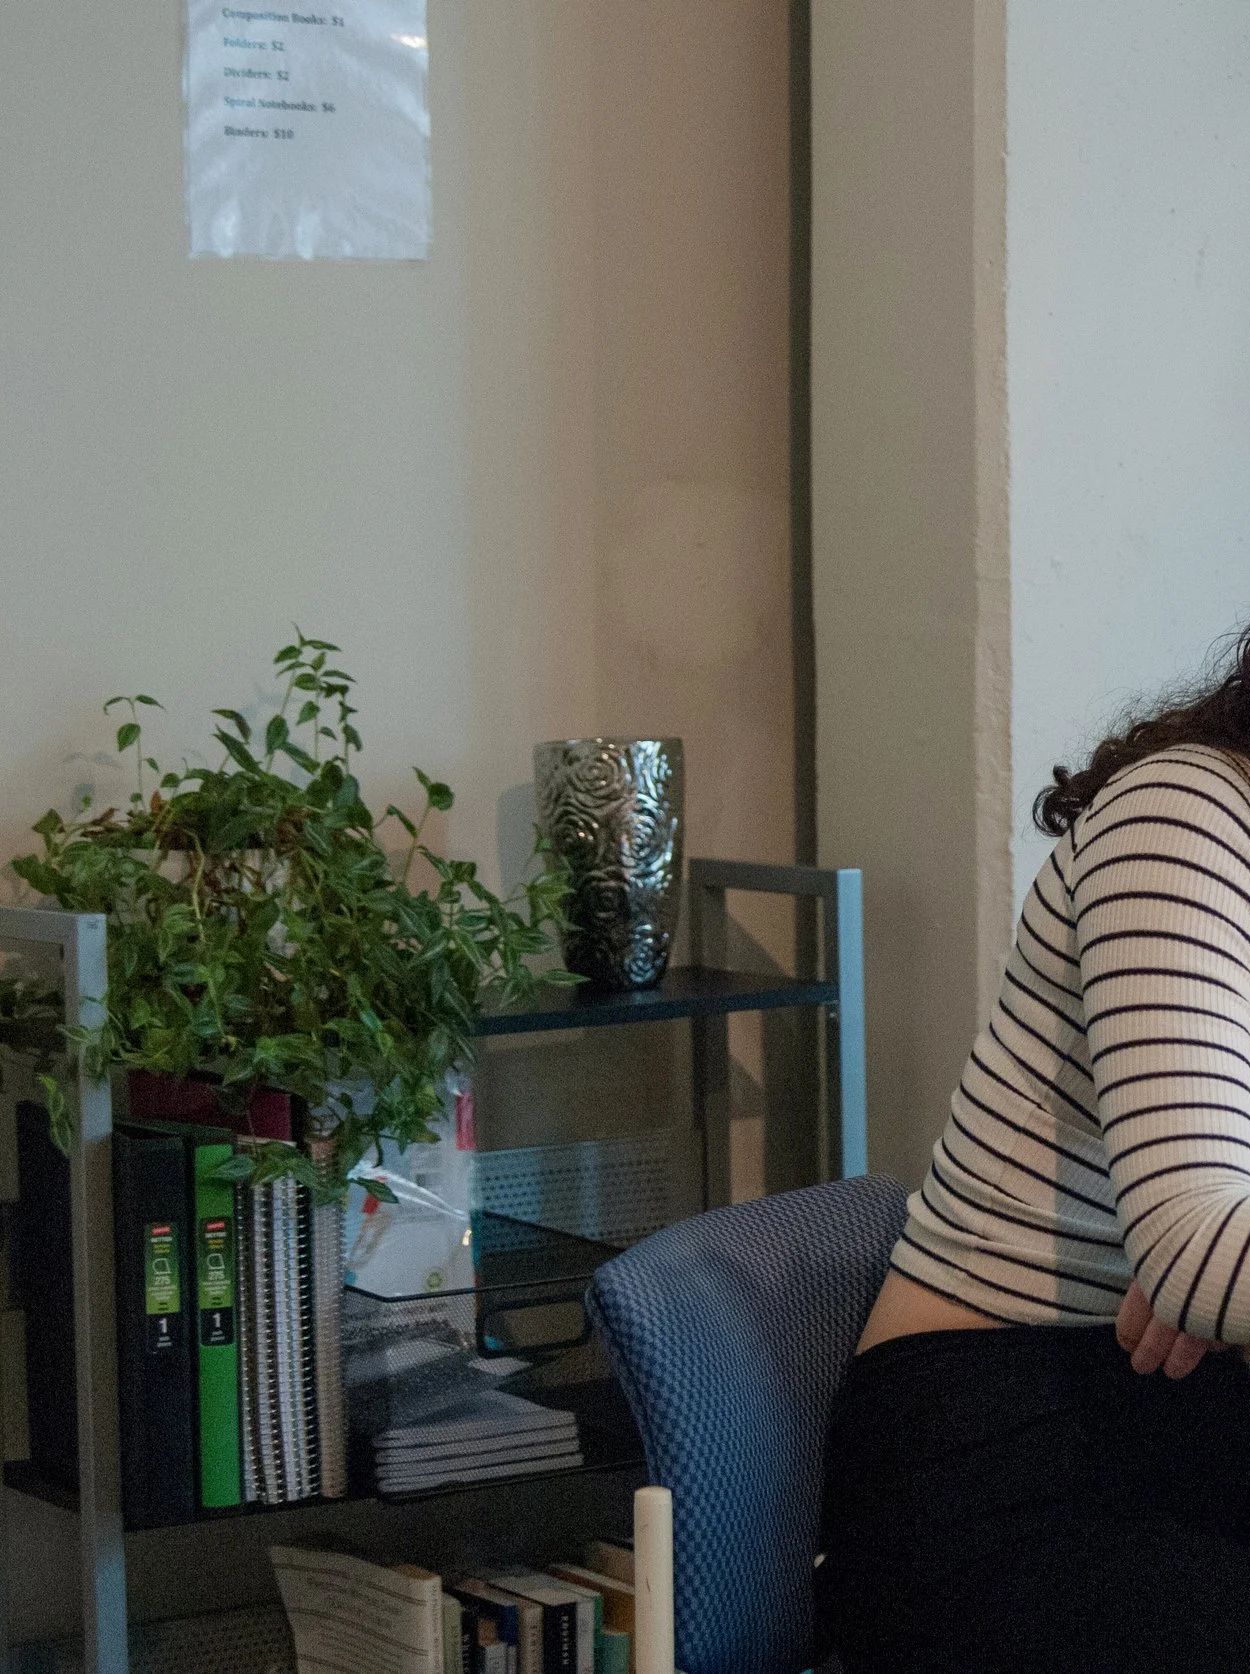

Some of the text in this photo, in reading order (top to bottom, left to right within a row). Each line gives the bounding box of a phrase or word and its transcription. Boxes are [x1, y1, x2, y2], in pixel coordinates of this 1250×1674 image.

[222, 8, 289, 22] Composition
[224, 126, 294, 140] Binders: $10
[159, 1318, 168, 1334] 1
[212, 1312, 222, 1328] 1
